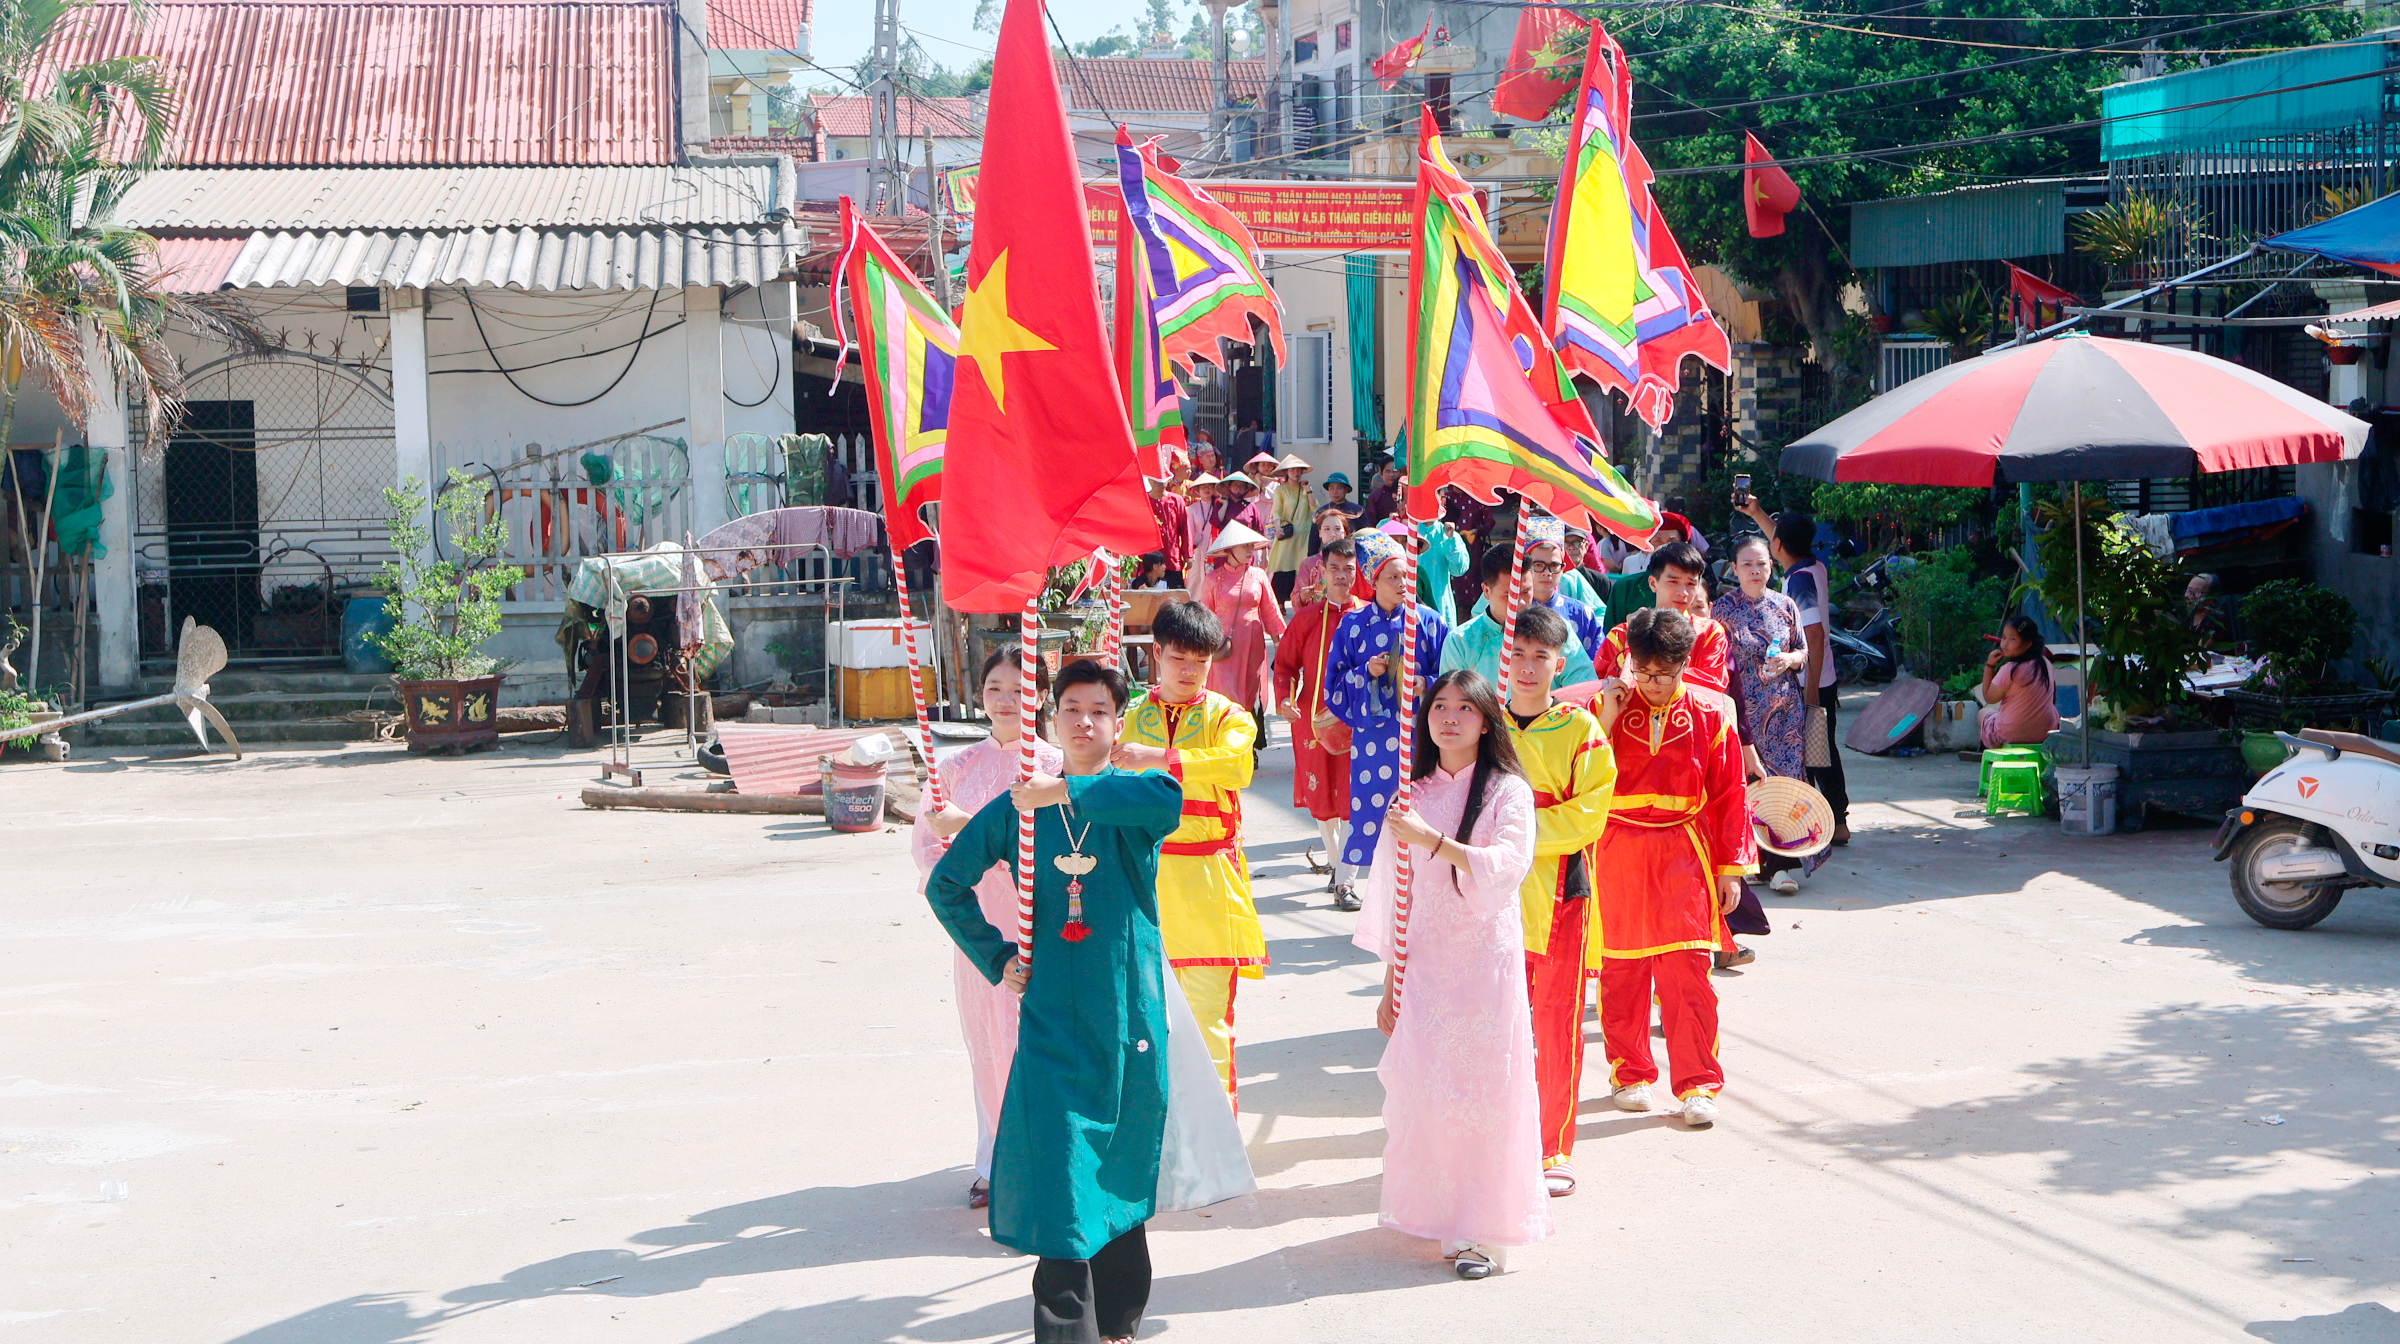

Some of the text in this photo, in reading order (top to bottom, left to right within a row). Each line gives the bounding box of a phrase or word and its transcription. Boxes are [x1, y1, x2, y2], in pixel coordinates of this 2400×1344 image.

[1239, 191, 1273, 205] TRUNG,
[1276, 190, 1302, 204] XUÂN
[1305, 190, 1329, 204] BÍNH
[1332, 192, 1351, 207] NGỌ
[1354, 190, 1377, 205] NĂM
[1379, 193, 1403, 205] 2026
[1253, 209, 1272, 224] TỨC
[1274, 209, 1300, 224] NGÀY
[1302, 211, 1326, 225] 4,5,6
[1328, 210, 1360, 225] THÁNG
[1362, 209, 1392, 225] GIÊNG
[1257, 230, 1282, 245] LẠCH
[1284, 231, 1312, 245] BẠNG
[835, 793, 874, 804] Seatech
[2347, 806, 2373, 822] Orla
